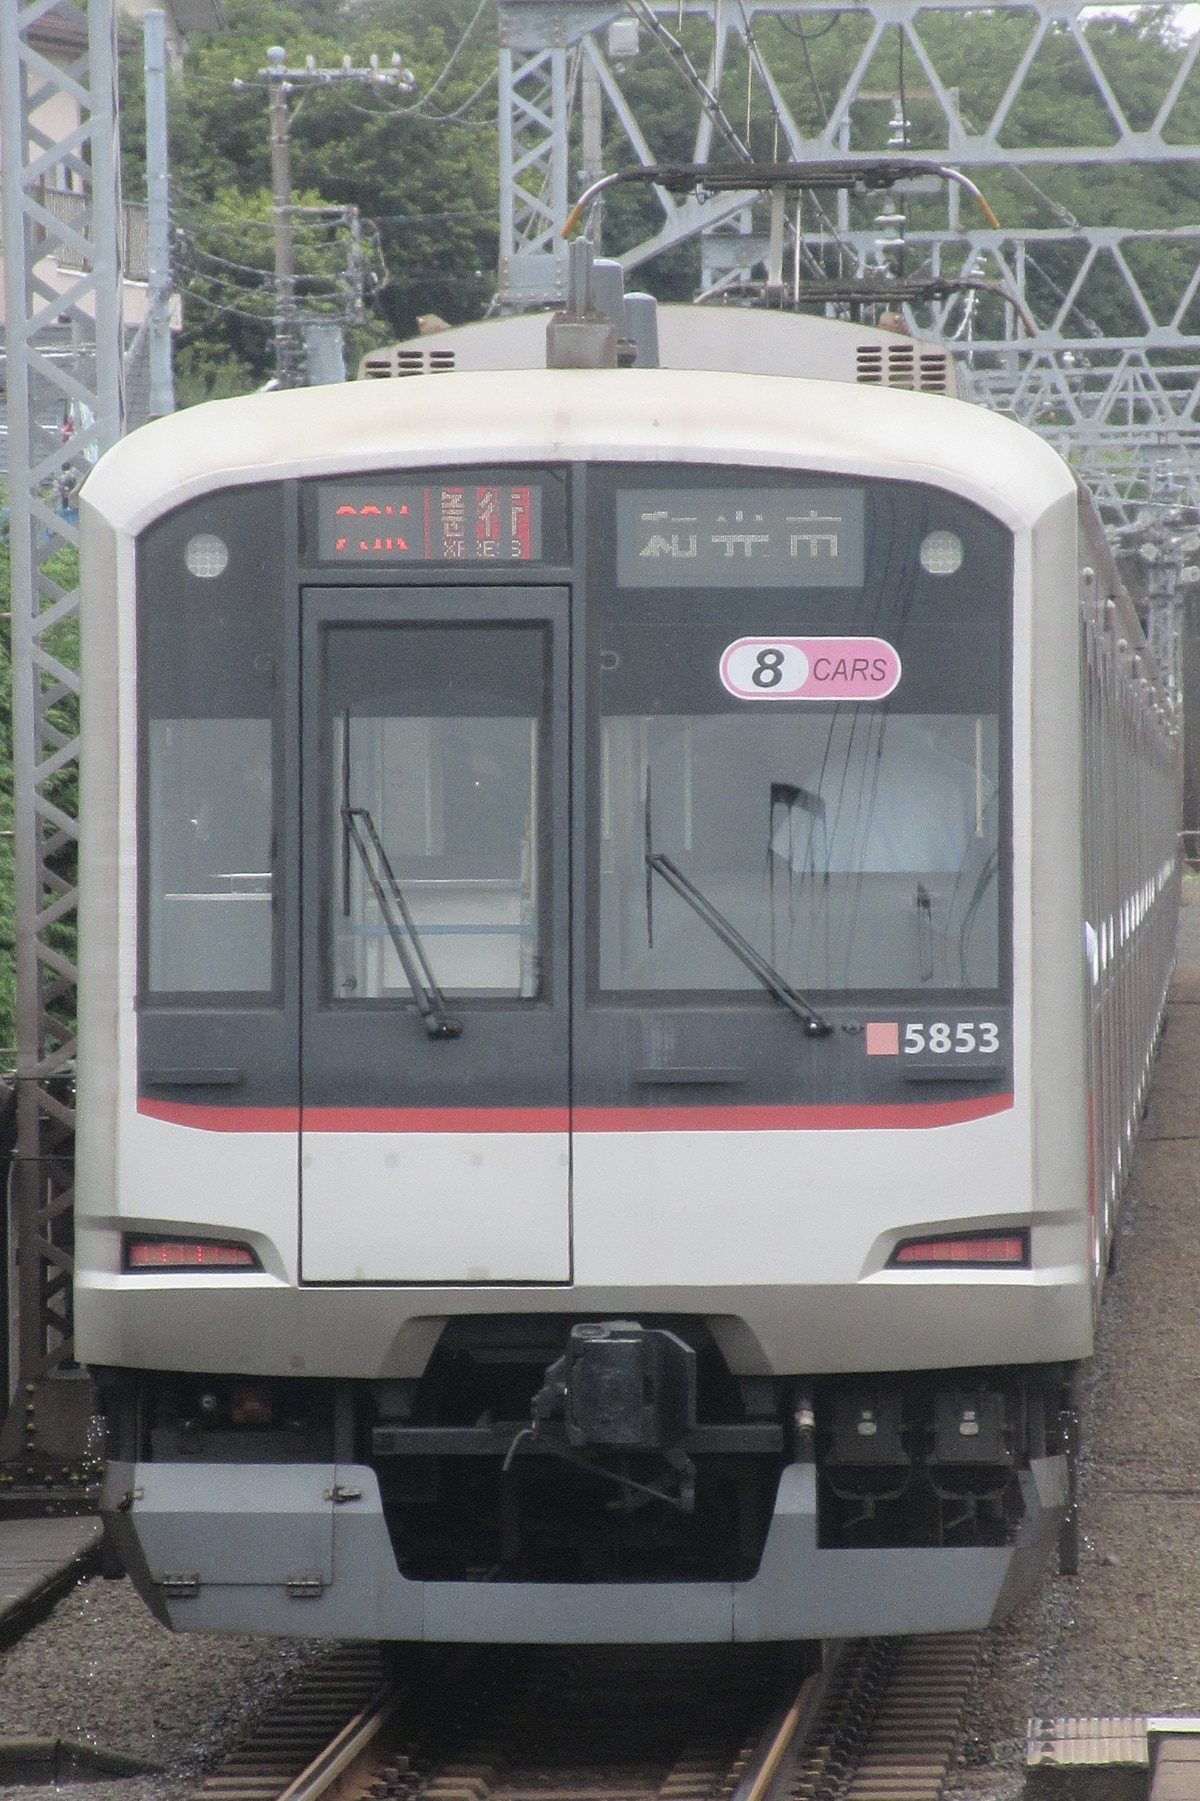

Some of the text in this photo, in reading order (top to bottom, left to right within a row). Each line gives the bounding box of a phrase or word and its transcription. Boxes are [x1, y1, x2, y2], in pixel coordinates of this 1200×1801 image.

[751, 648, 887, 688] 8 CARS
[904, 1022, 1000, 1054] 5853
